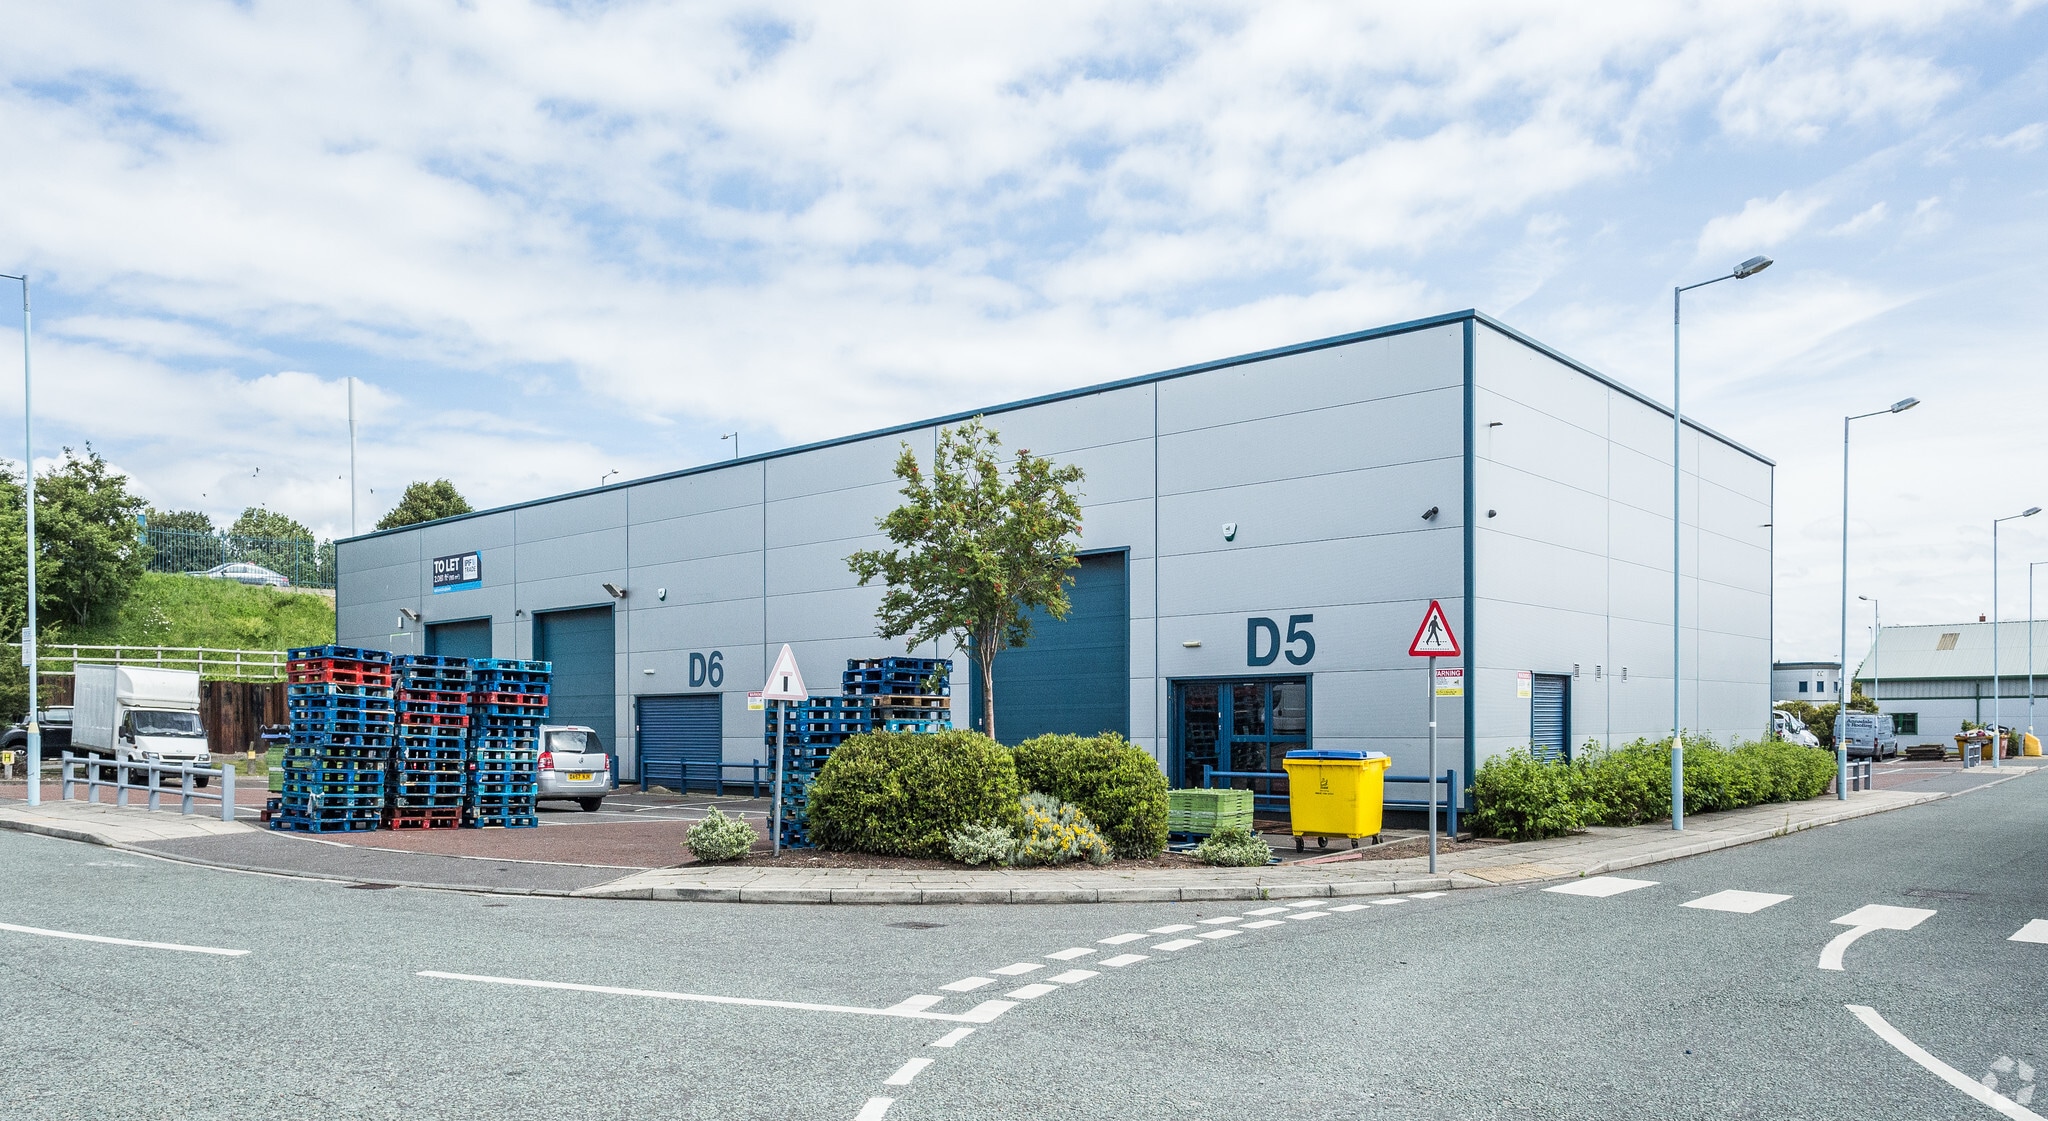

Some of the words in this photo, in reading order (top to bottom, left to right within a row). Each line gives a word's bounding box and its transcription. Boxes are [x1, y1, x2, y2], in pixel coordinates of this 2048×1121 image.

[434, 560, 445, 574] TO
[446, 558, 460, 572] LET
[1247, 613, 1316, 667] D5
[689, 650, 724, 688] D6
[4, 753, 11, 763] H
